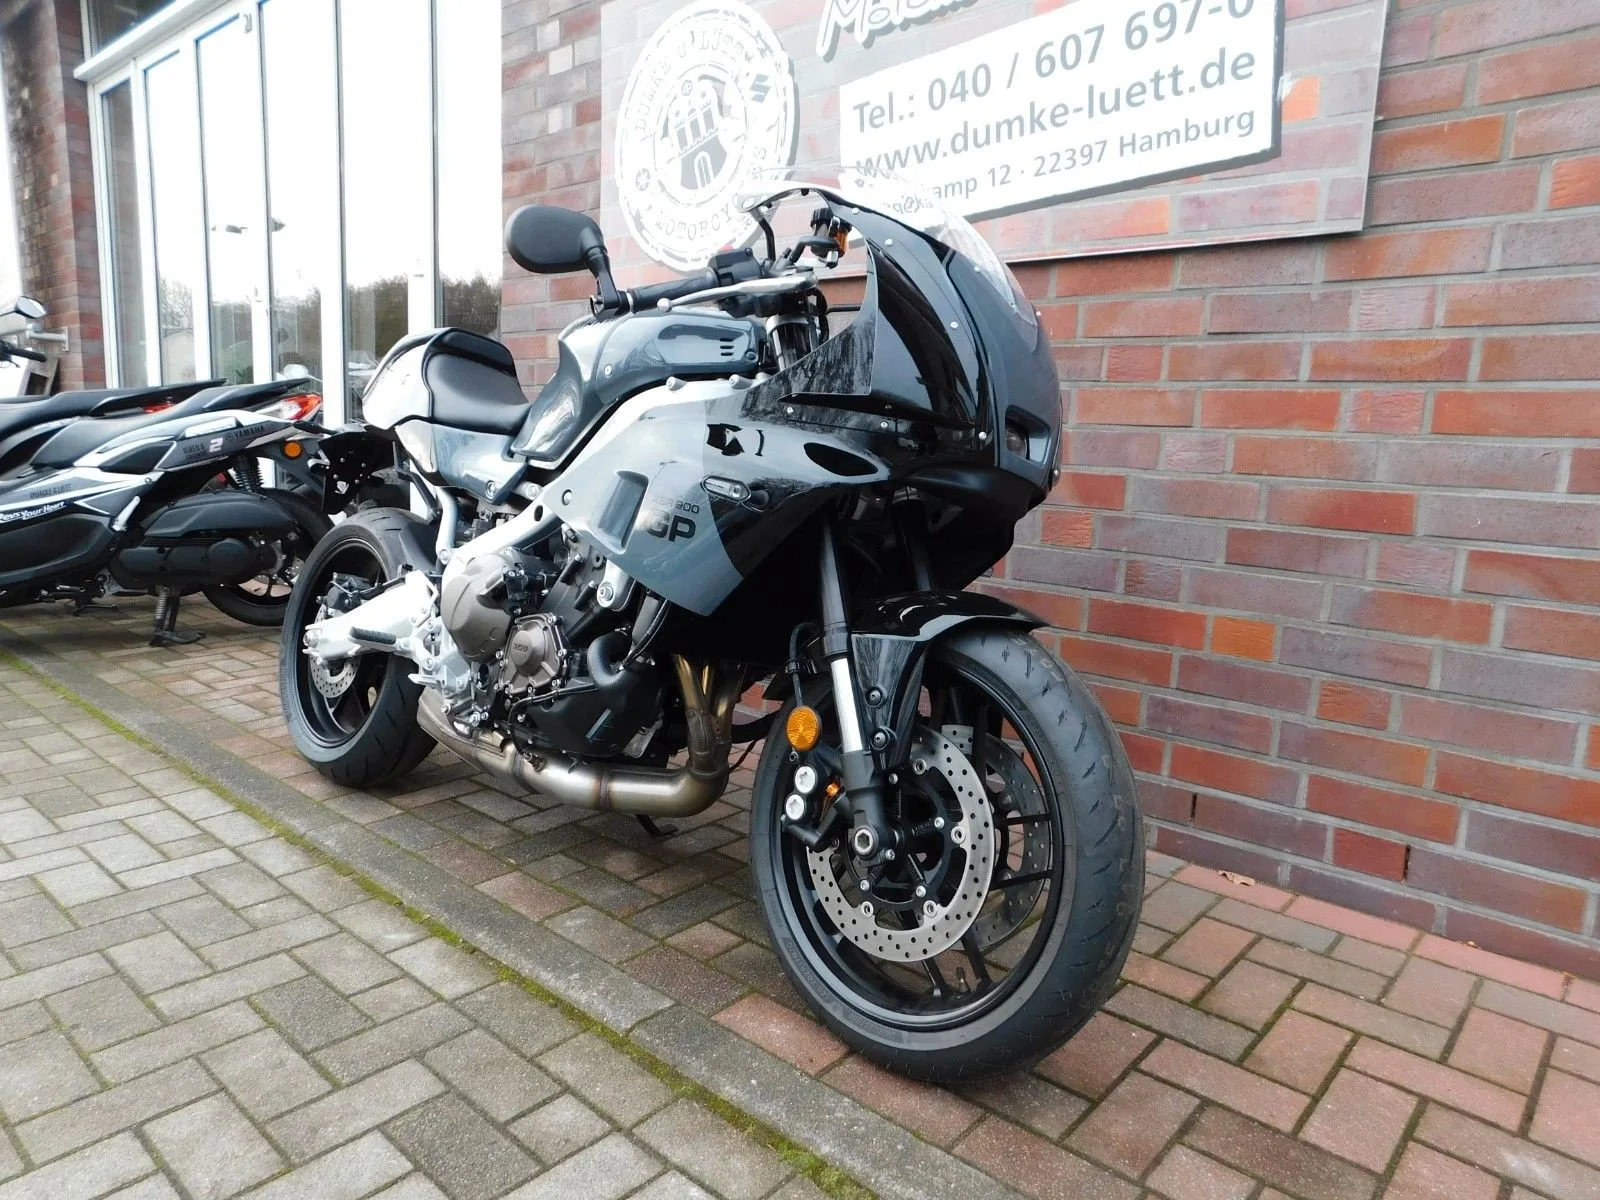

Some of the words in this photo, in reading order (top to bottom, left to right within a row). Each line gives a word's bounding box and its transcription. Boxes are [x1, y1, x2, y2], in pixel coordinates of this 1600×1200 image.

[852, 91, 915, 133] Tel.:
[928, 62, 992, 111] 040
[1006, 51, 1020, 89] /
[1035, 23, 1105, 78] 607
[1124, 0, 1253, 51] 697-0
[855, 46, 1256, 178] www.dumke-luett.de
[987, 163, 1012, 188] 12
[1033, 139, 1109, 178] 22397
[1118, 109, 1255, 158] Hamburg
[208, 437, 224, 453] 2
[233, 424, 265, 438] YAMAHA
[21, 508, 43, 521] Your
[646, 508, 697, 543] GP
